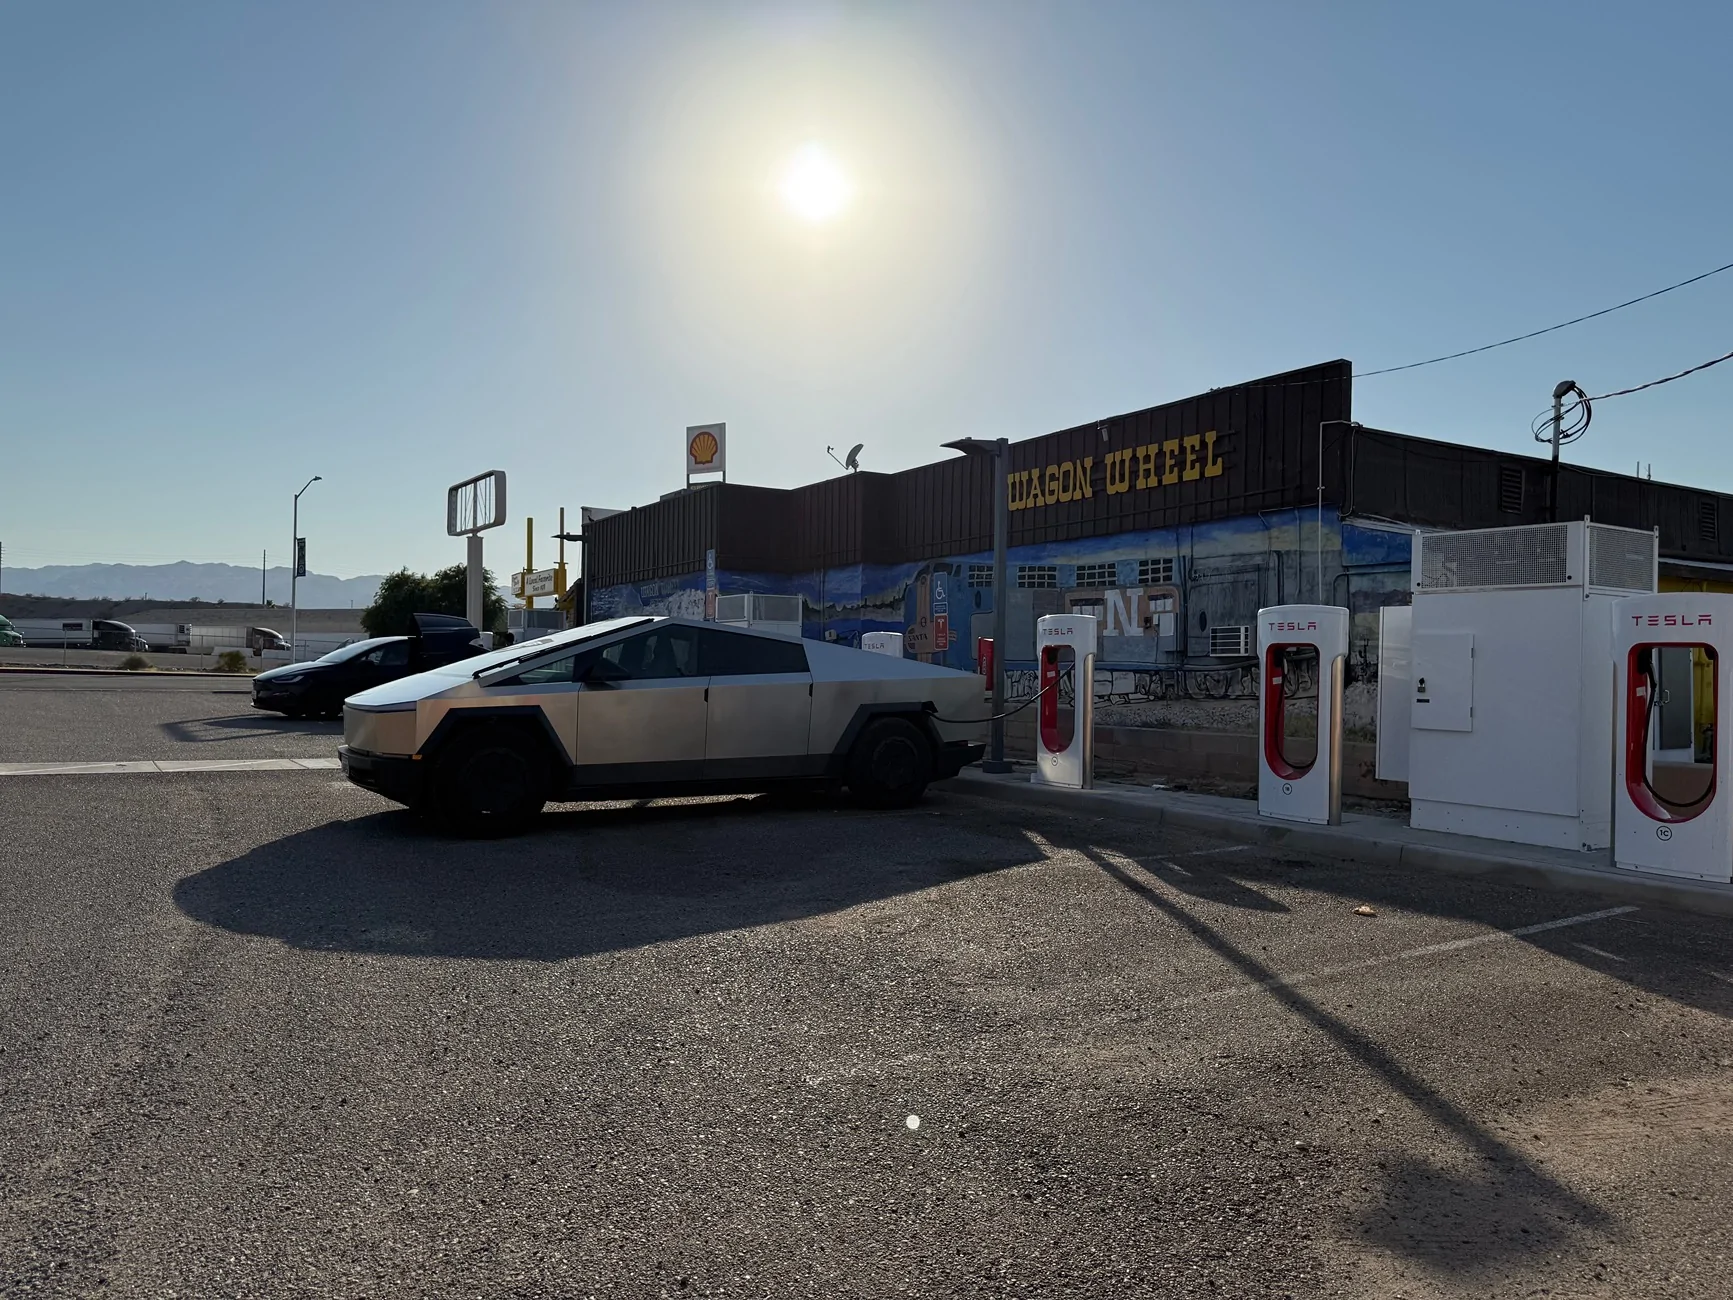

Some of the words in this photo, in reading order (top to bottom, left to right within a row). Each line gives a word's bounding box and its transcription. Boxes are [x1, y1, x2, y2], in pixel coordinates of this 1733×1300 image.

[1008, 456, 1093, 511] WAGON
[1104, 430, 1223, 495] WHEEL
[1631, 614, 1712, 626] TESLA
[1268, 622, 1317, 631] TESLA
[1042, 627, 1073, 636] TESLA
[863, 642, 885, 650] TESLA
[1659, 829, 1669, 837] 1C
